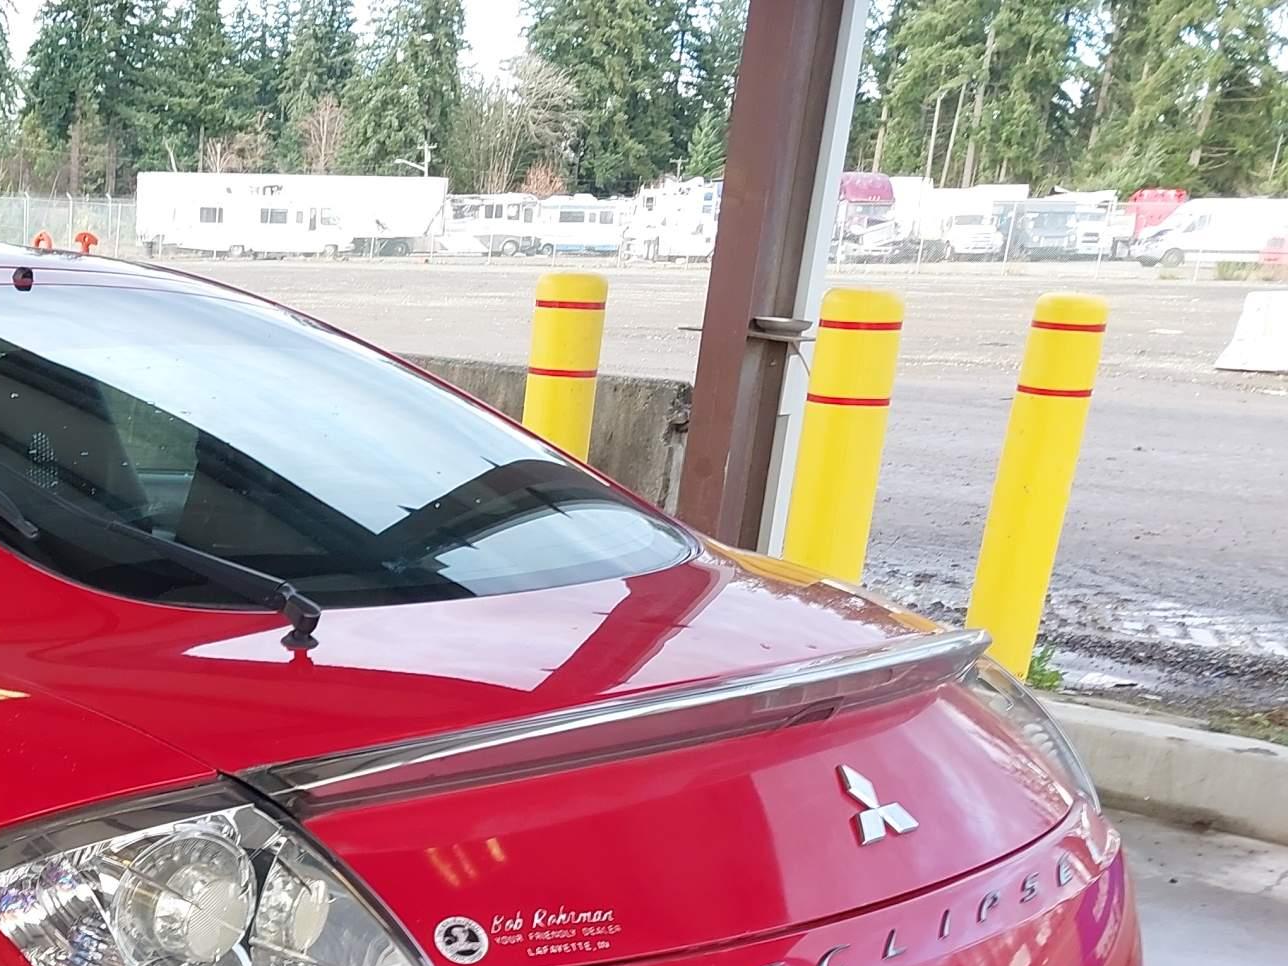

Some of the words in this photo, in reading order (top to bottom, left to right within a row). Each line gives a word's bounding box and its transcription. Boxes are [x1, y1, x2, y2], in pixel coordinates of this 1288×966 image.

[491, 910, 524, 934] Bob
[494, 934, 524, 945] YOUR
[528, 928, 577, 941] FRIENDLY
[581, 924, 623, 937] DEALER
